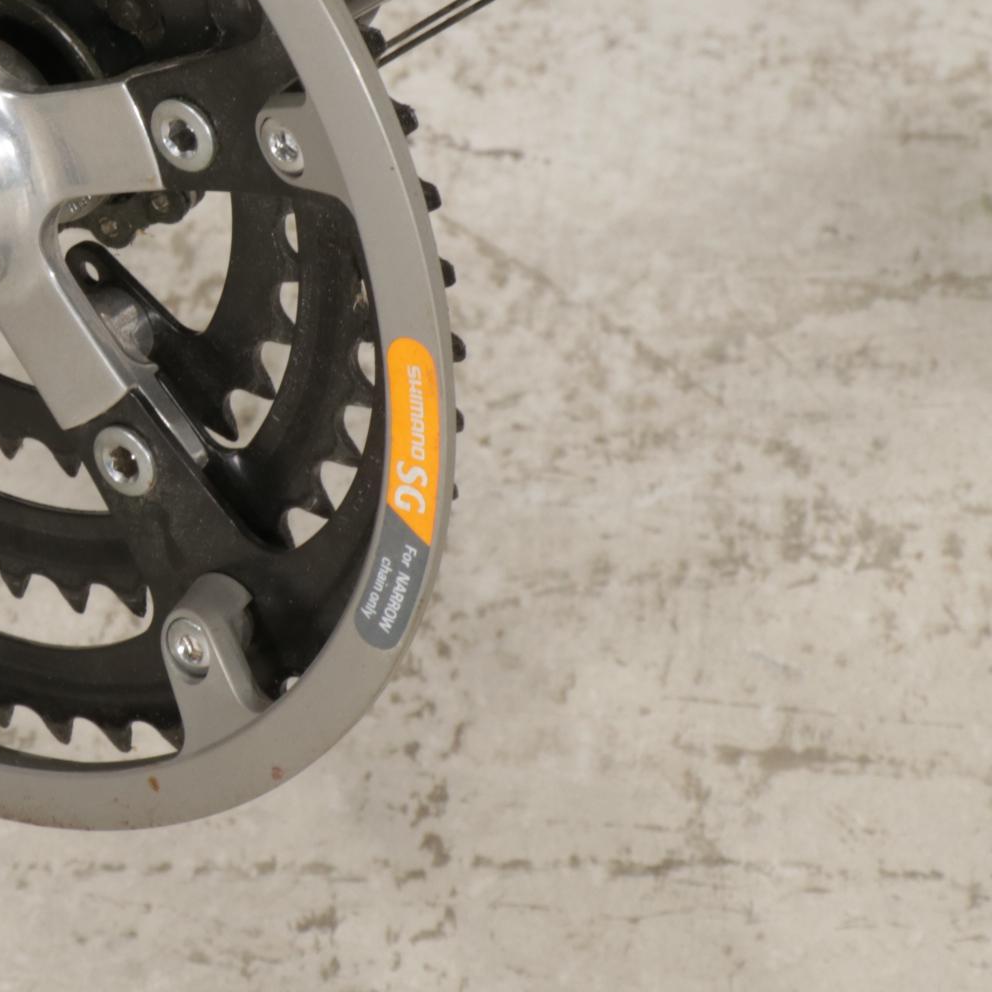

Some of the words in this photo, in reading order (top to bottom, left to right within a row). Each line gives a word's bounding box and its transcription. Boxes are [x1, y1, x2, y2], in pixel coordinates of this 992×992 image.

[408, 364, 426, 461] SHIMANO
[393, 460, 429, 515] SG
[373, 556, 393, 592] chain
[401, 544, 418, 568] For
[360, 591, 380, 620] only
[378, 571, 411, 634] NARROW
